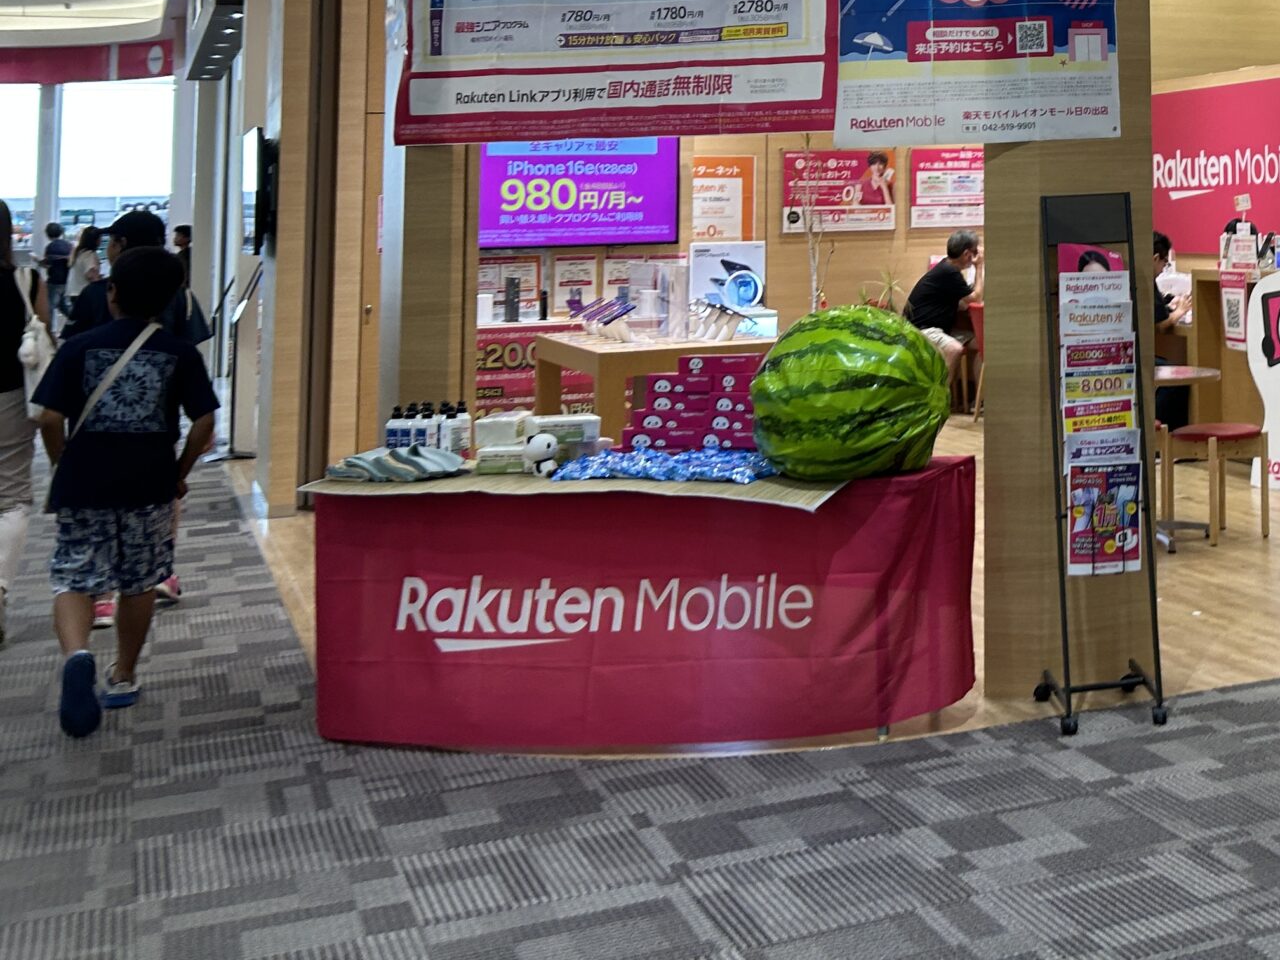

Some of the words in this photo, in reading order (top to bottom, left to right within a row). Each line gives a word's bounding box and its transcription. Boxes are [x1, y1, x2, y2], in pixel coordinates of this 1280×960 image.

[915, 42, 1004, 55] 来店予約はこちら
[456, 91, 505, 104] Rakuten
[963, 106, 1108, 121] 楽天モバイルイオンモール日の出店
[851, 117, 904, 132] Rakuten
[906, 115, 945, 128] Moble
[507, 161, 564, 176] iPhone
[1152, 150, 1233, 199] Rakuten
[396, 574, 625, 652] Rakuten
[635, 572, 814, 631] Mobile
